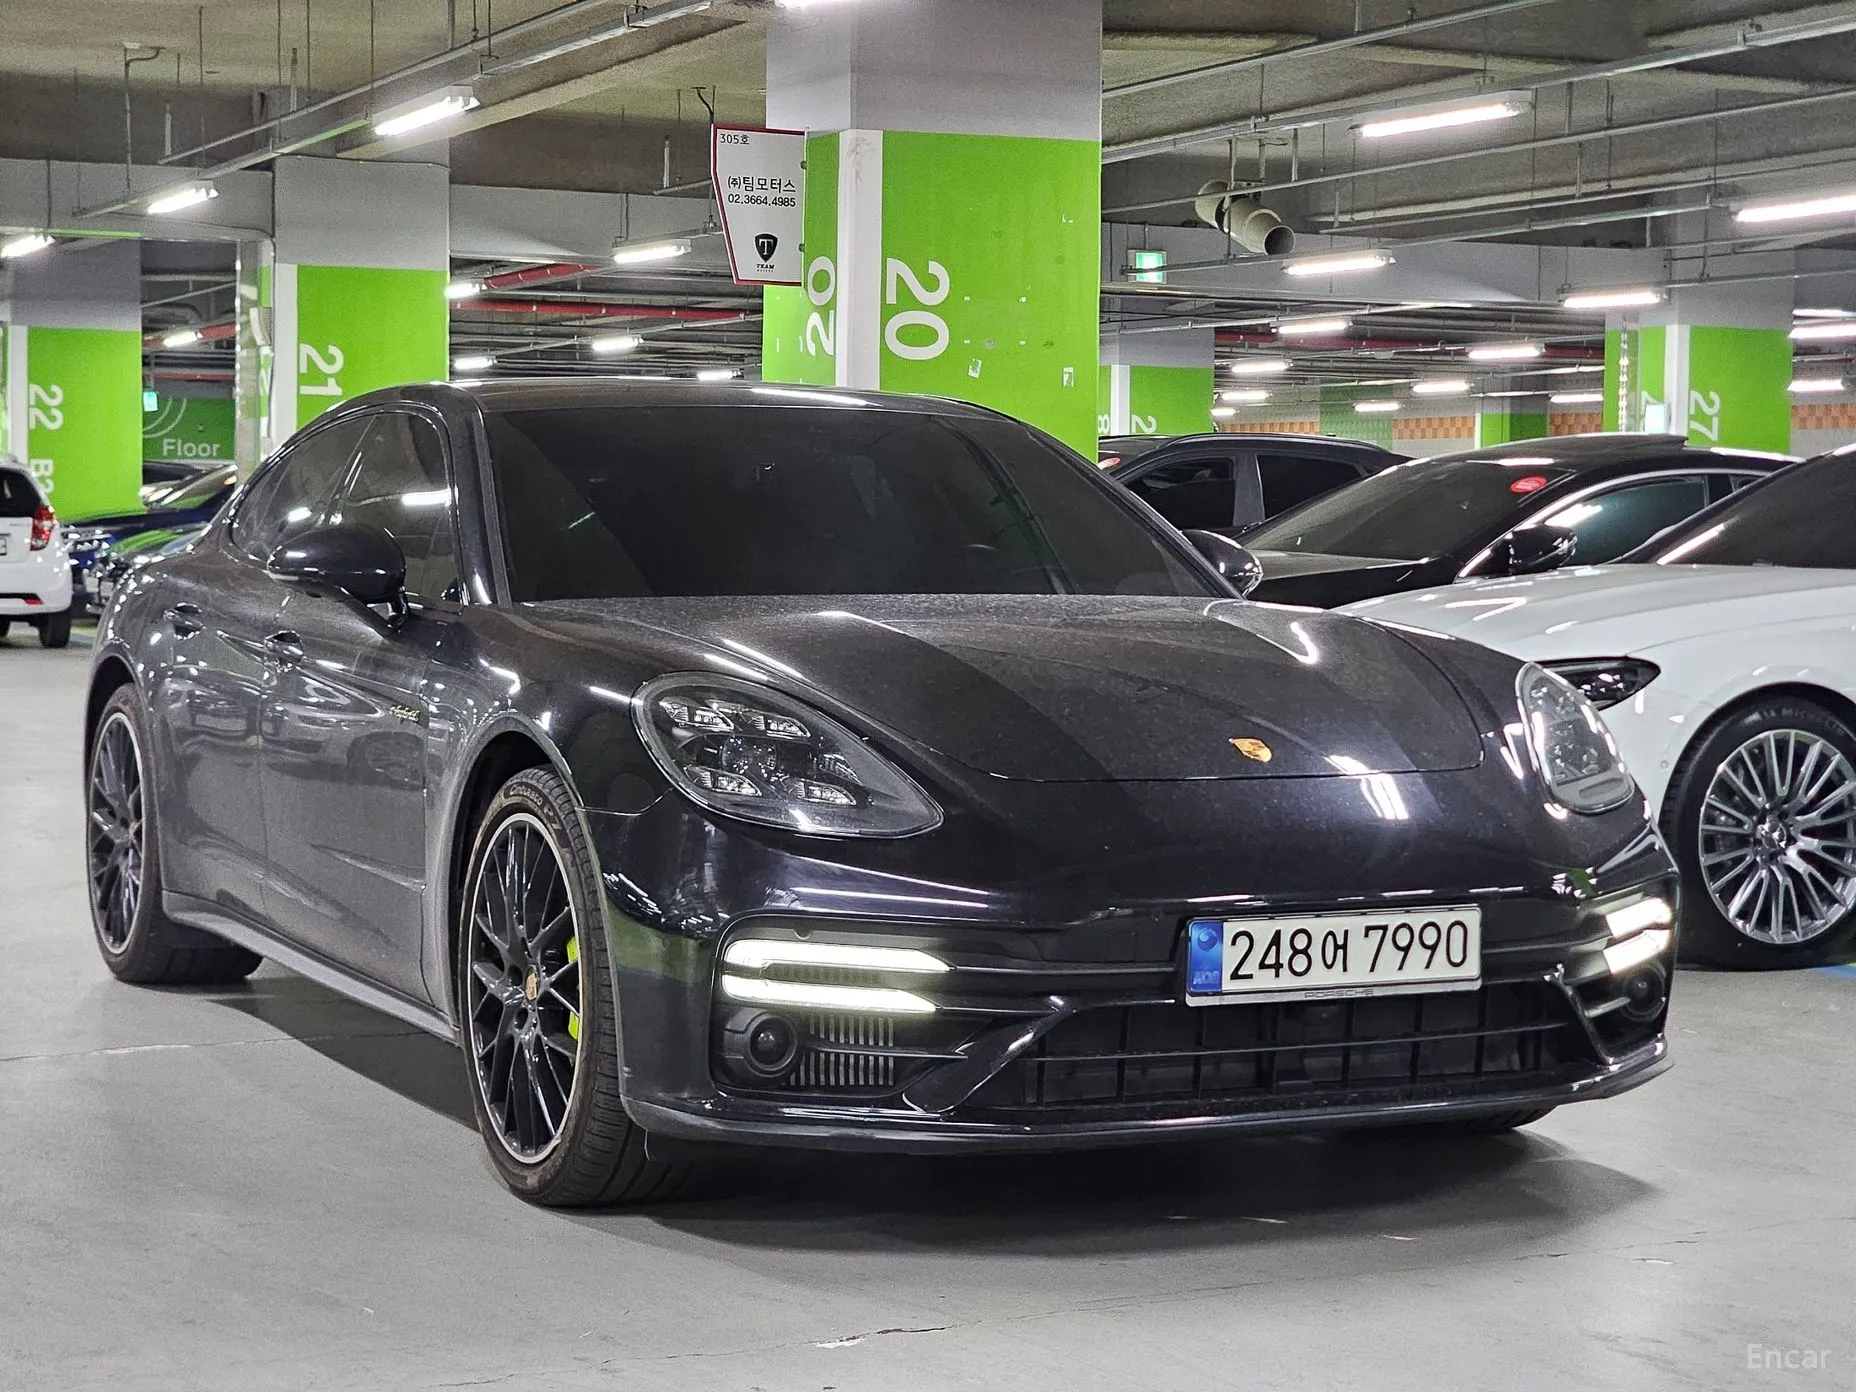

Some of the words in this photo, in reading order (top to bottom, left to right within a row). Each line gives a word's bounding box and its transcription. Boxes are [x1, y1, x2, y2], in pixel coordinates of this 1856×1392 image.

[720, 133, 750, 145] 305호
[727, 193, 797, 207] 02.3664.4985
[805, 255, 836, 357] 20
[884, 257, 951, 361] 20
[299, 342, 344, 396] 21
[29, 383, 64, 430] 22
[1689, 389, 1721, 442] 27
[162, 438, 220, 457] Floor
[1229, 928, 1350, 981] 248어
[1363, 919, 1469, 973] 7990
